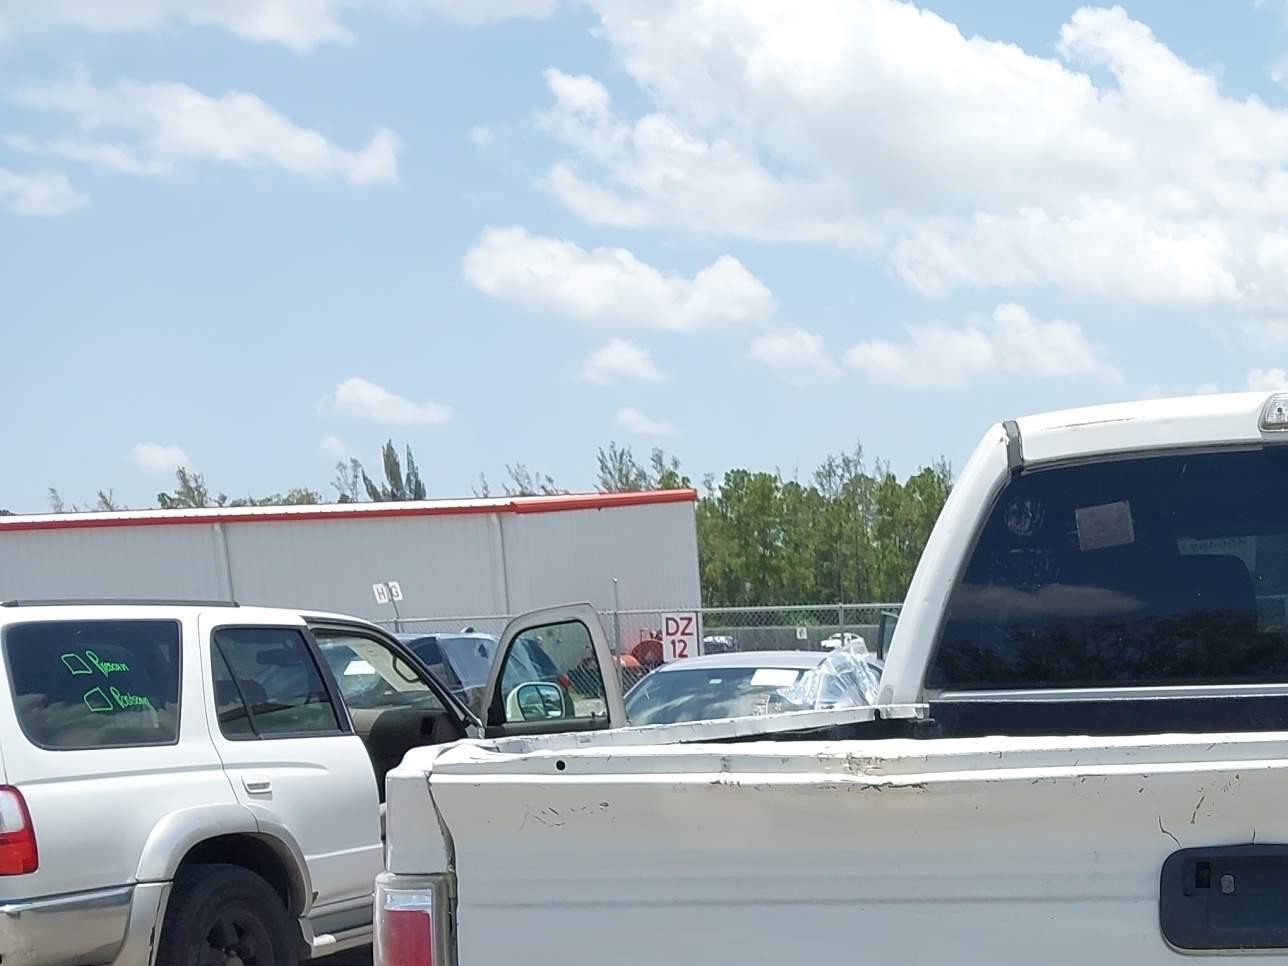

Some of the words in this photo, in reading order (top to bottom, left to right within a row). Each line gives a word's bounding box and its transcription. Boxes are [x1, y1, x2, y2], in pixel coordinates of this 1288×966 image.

[377, 587, 387, 601] H
[665, 617, 693, 636] DZ
[670, 639, 688, 658] 12
